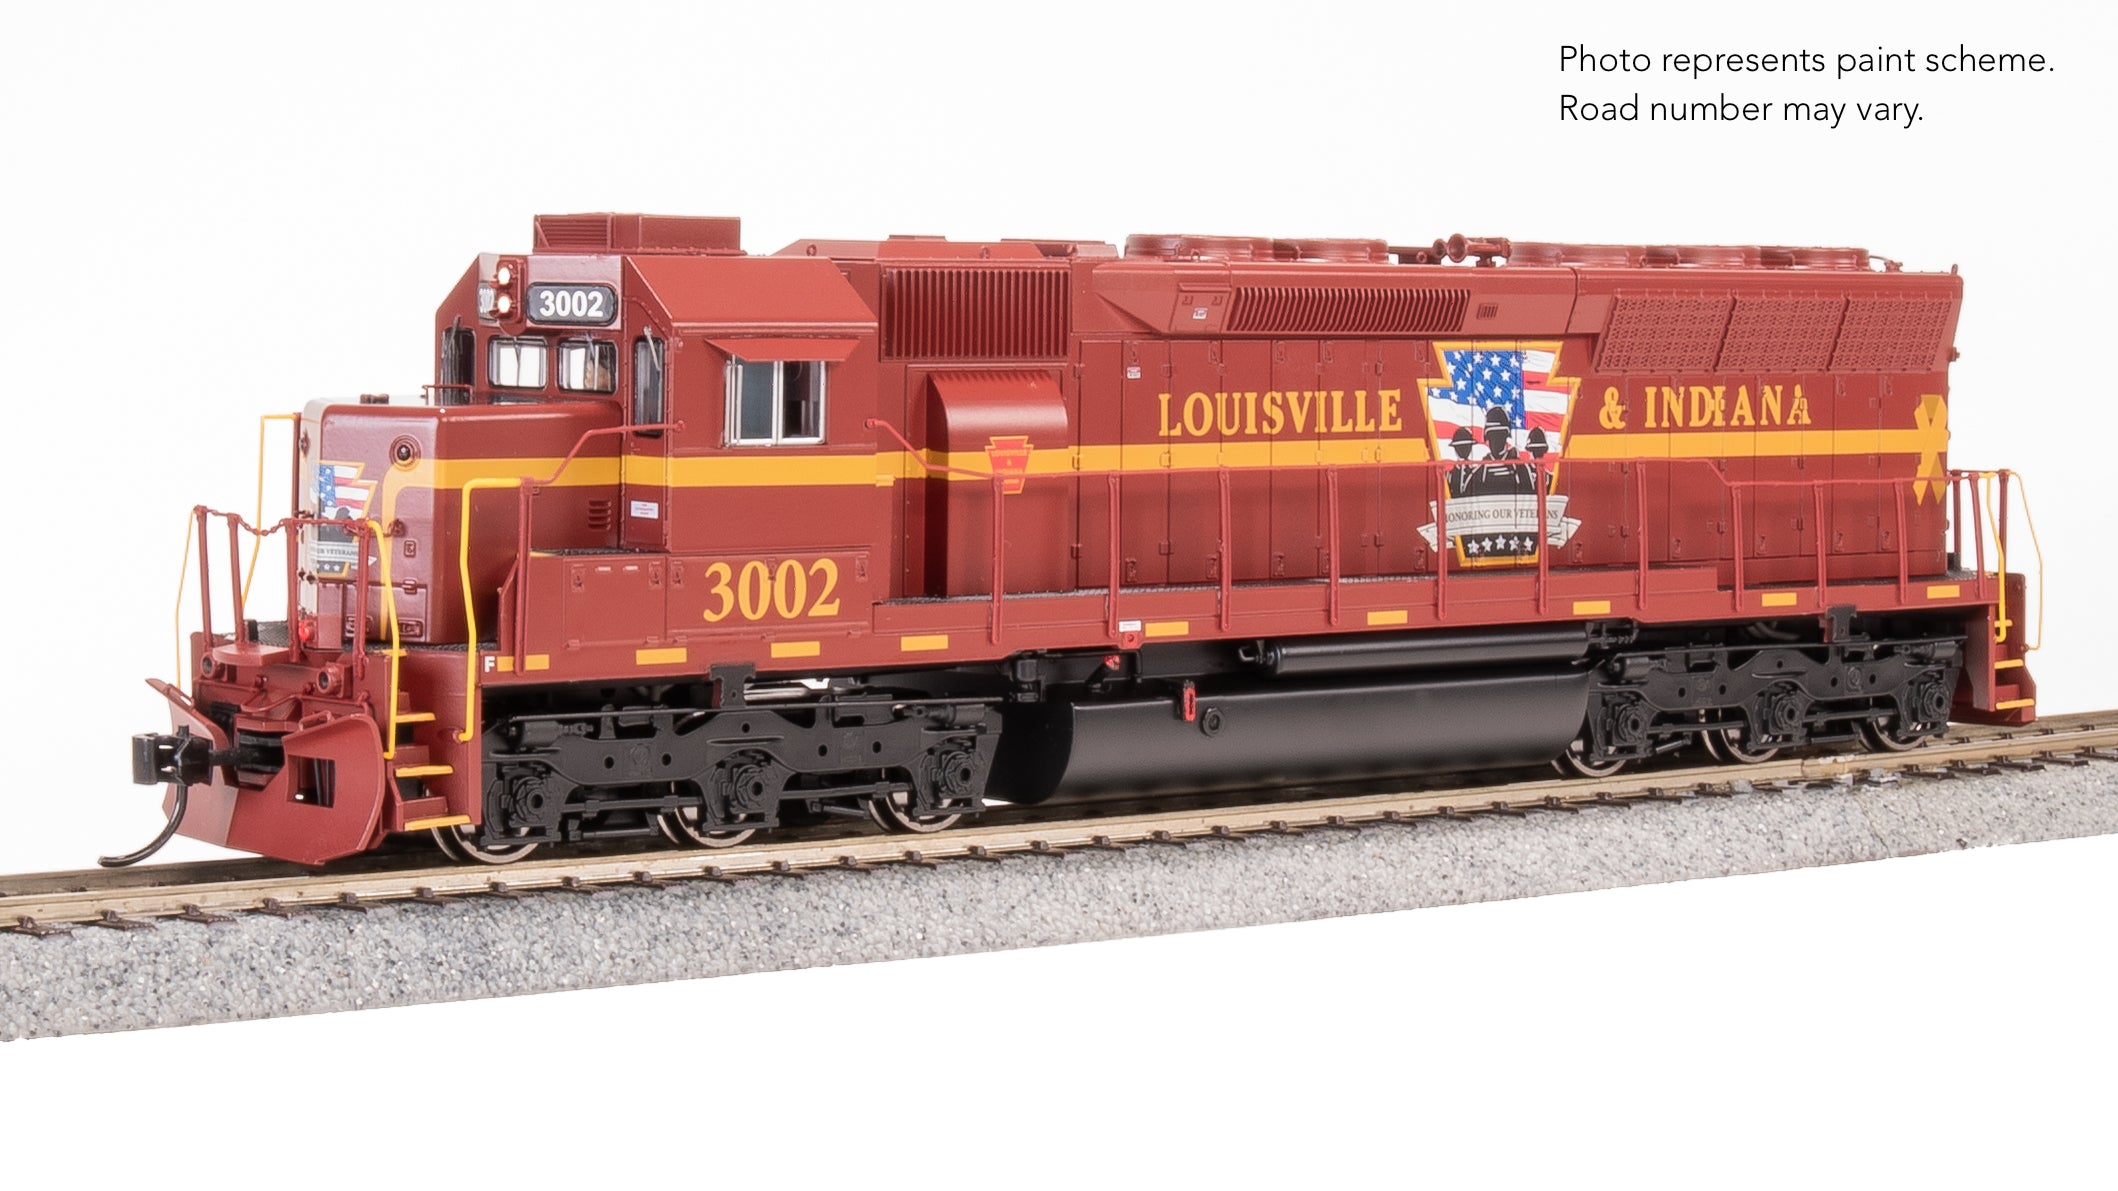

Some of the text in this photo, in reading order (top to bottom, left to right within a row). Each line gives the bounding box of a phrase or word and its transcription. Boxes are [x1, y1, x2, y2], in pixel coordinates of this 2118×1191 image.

[539, 290, 604, 317] 3002
[1158, 384, 1812, 437] LOUISVILLE & INDIANA
[1492, 508, 1513, 519] OUR
[703, 558, 841, 622] 3002
[485, 656, 495, 672] F
